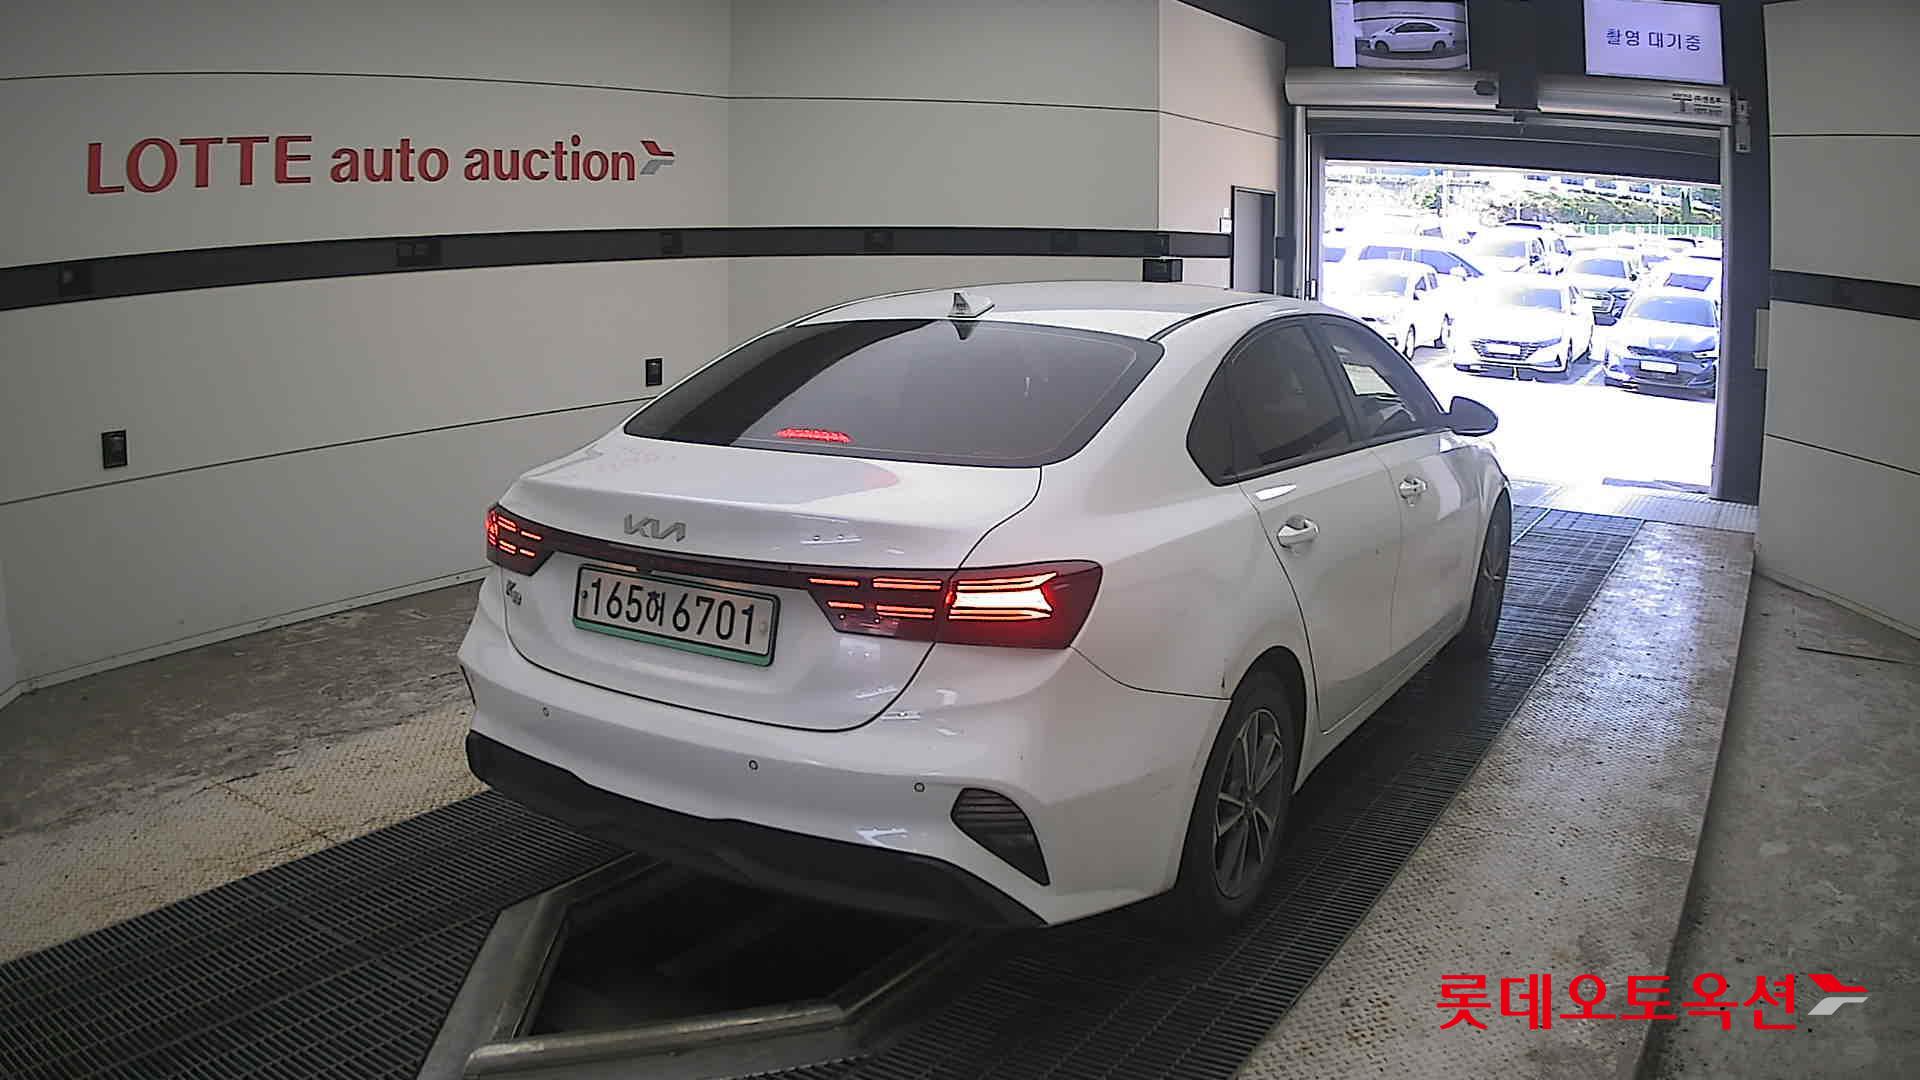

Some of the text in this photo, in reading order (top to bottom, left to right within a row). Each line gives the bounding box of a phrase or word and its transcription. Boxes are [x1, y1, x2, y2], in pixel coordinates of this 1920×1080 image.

[1648, 31, 1702, 52] 대기중
[87, 134, 637, 194] LOTTE auto auction
[624, 514, 687, 542] KIA
